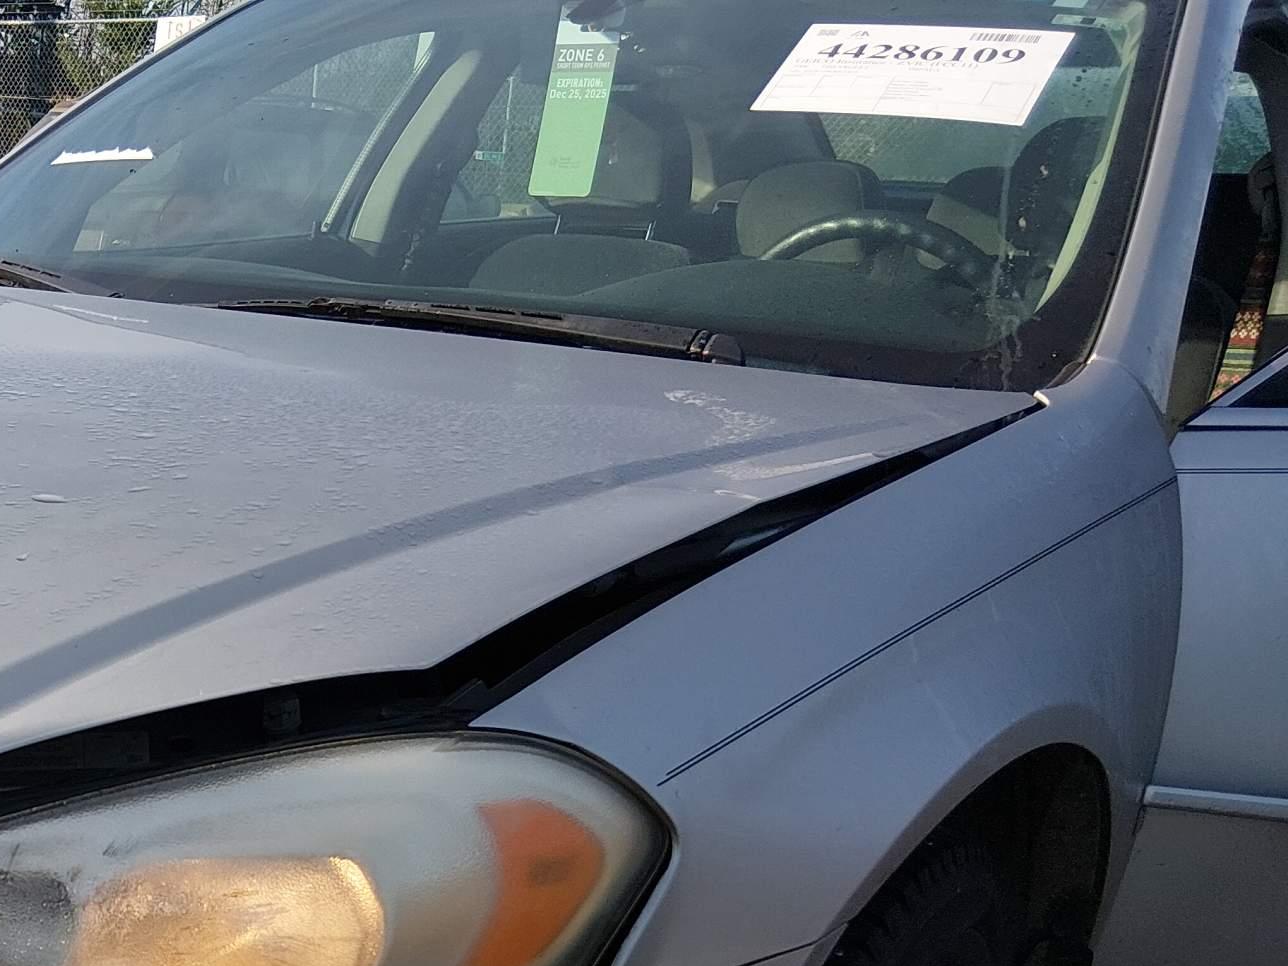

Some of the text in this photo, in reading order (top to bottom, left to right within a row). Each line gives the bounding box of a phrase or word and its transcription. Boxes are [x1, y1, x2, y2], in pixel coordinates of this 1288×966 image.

[558, 48, 605, 61] ZONE 6
[817, 43, 1026, 64] 44286109
[550, 88, 608, 100] Dec 25, 2025
